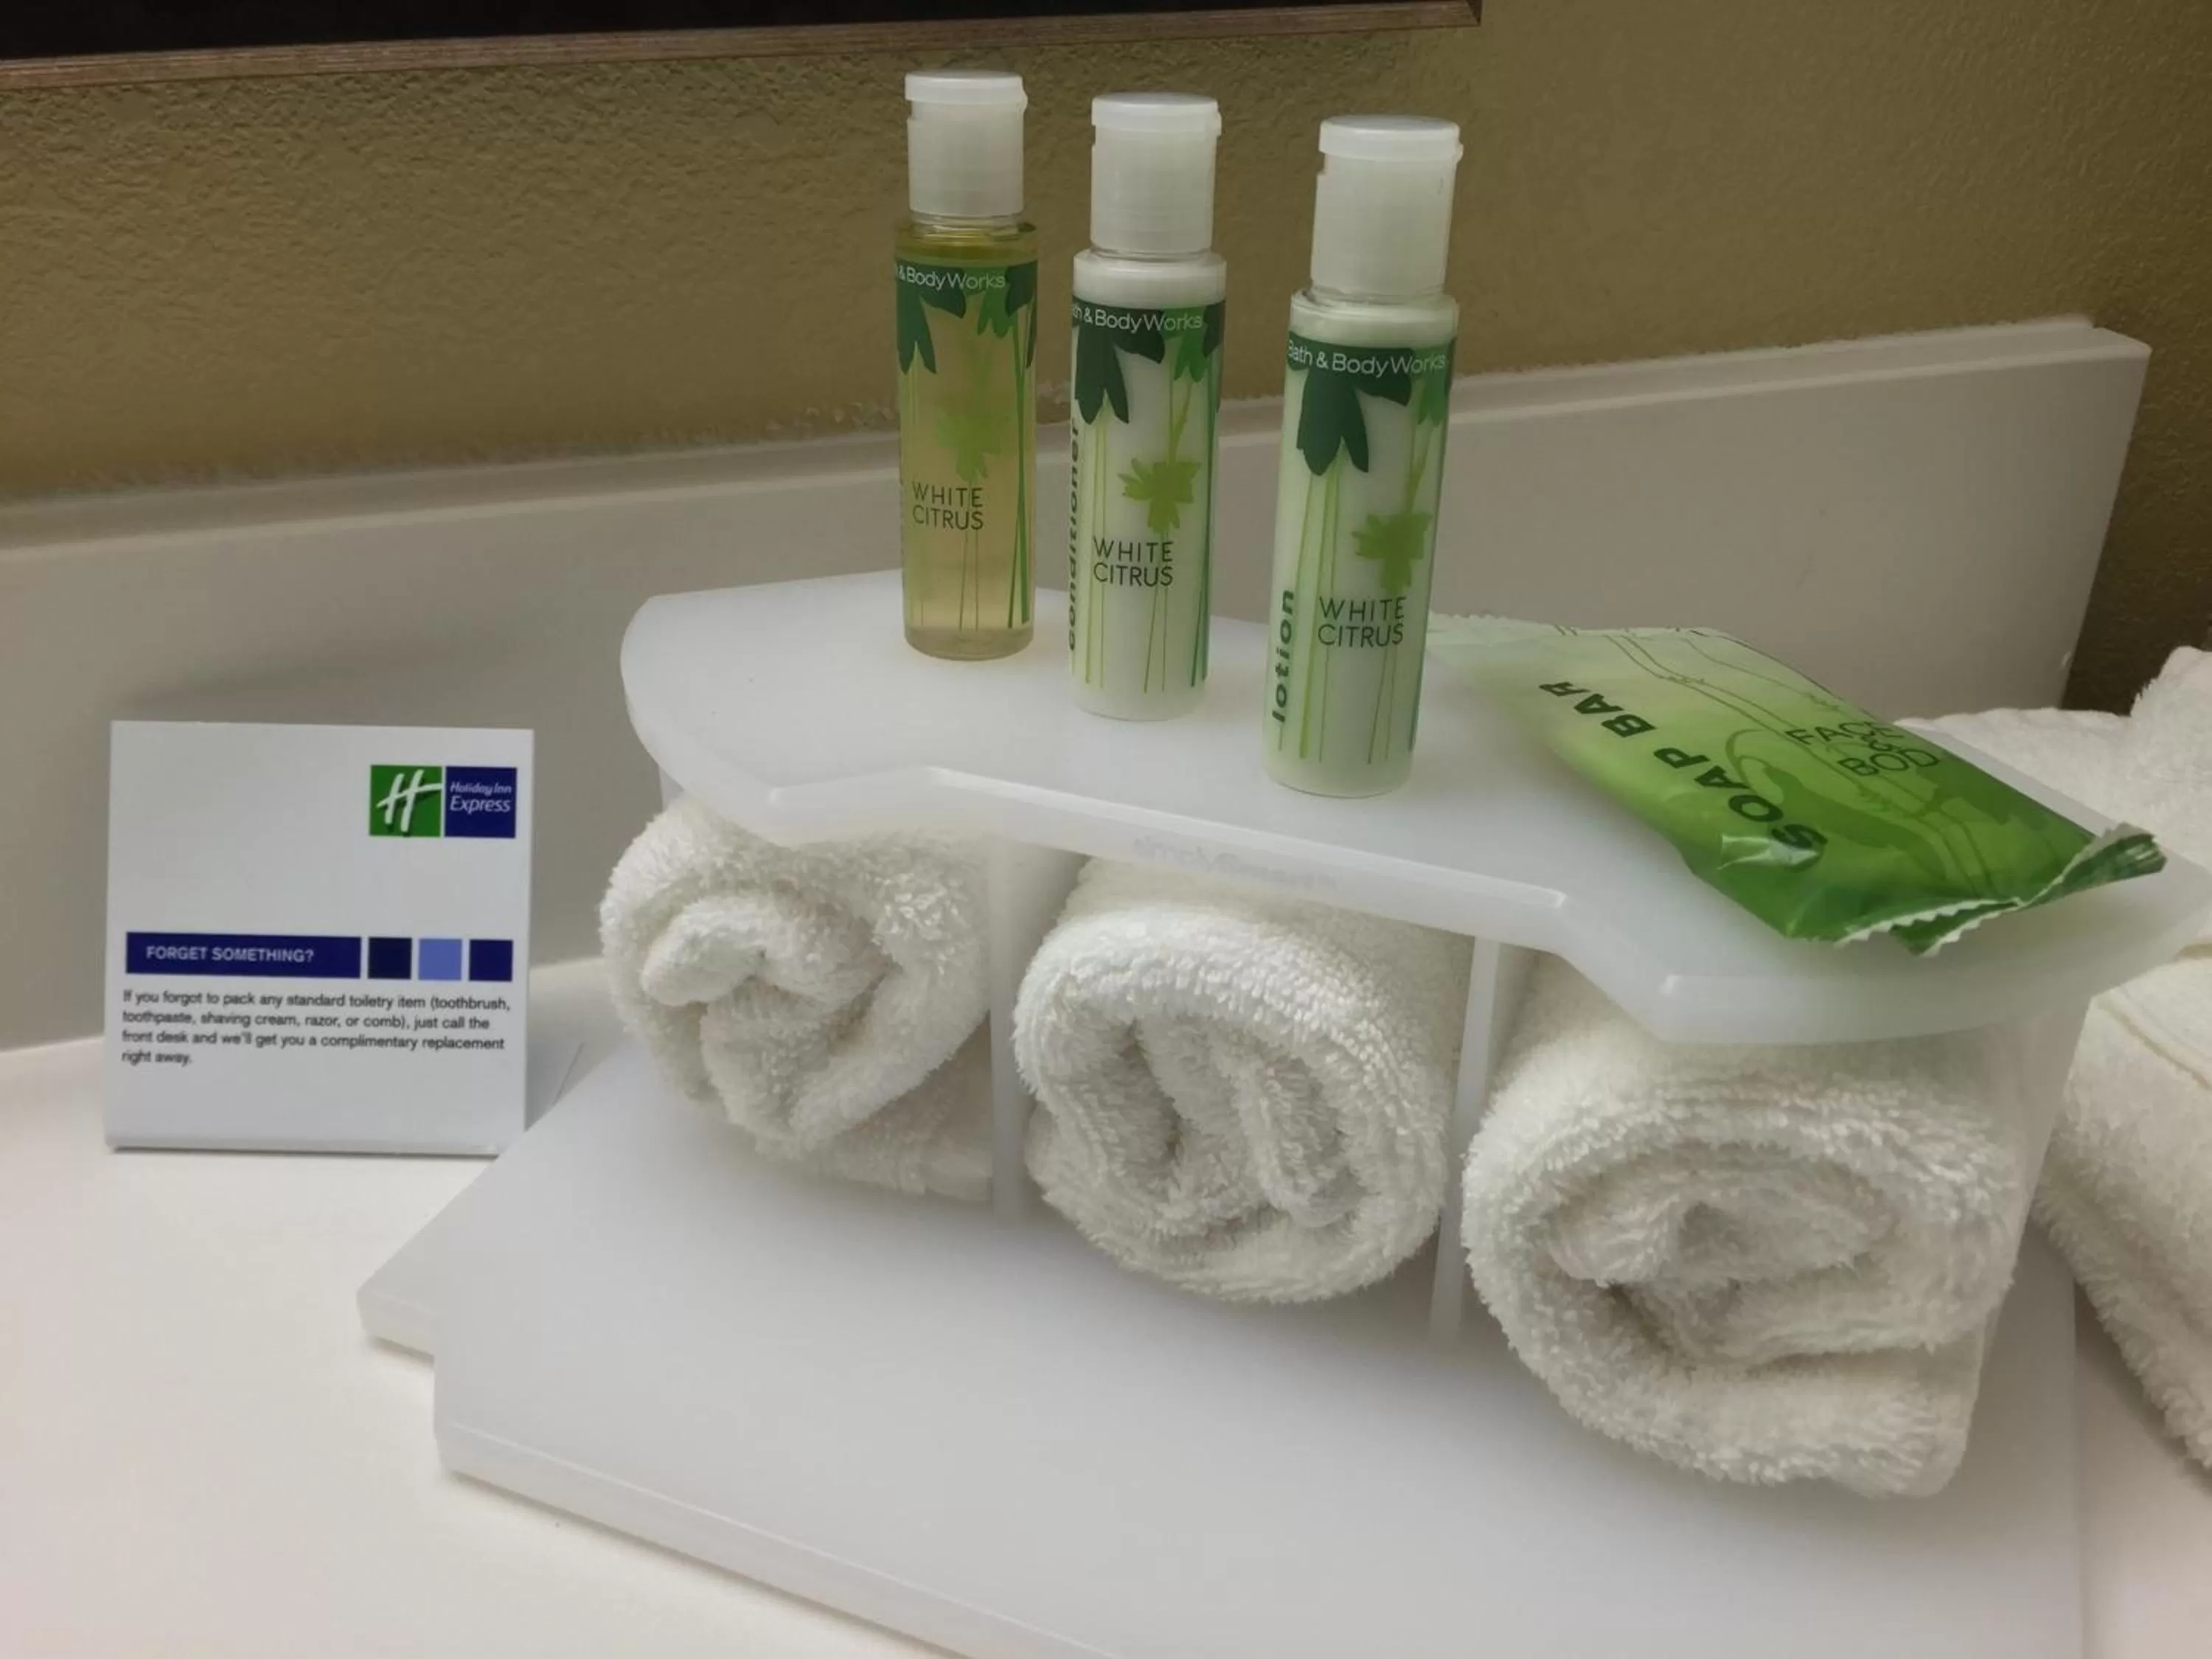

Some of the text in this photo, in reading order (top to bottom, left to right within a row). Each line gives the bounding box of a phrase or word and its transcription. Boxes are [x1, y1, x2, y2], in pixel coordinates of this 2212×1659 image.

[906, 265, 945, 291] Body
[946, 272, 1006, 290] Works
[1084, 306, 1093, 324] &
[1094, 308, 1142, 334] Body
[1143, 313, 1203, 331] Works
[1316, 350, 1329, 369] &
[1332, 352, 1389, 378] Body
[1390, 354, 1447, 375] Works
[912, 481, 984, 508] WHITE
[912, 504, 984, 530] CITRUS
[1069, 417, 1079, 651] conditioner
[1093, 536, 1174, 563] WHITE
[1093, 562, 1174, 588] CITRUS
[1319, 596, 1407, 622] WHITE
[1318, 622, 1404, 648] CITRUS
[1272, 590, 1294, 723] lotion
[1539, 681, 1829, 850] SOAP BAR
[1837, 748, 1941, 776] BOD
[450, 782, 512, 796] Holiday Inn
[450, 796, 511, 815] Express
[146, 945, 314, 963] FORGET SOMETHING?
[123, 990, 510, 1012] If you forgot to pack any standard toiletry item (toothbrush,
[122, 1010, 490, 1031] toothpaste, shaving cream, razor, or comb), just call the
[122, 1030, 505, 1051] front desk and we'll get you a complimentary replacement
[121, 1051, 192, 1067] right away.
